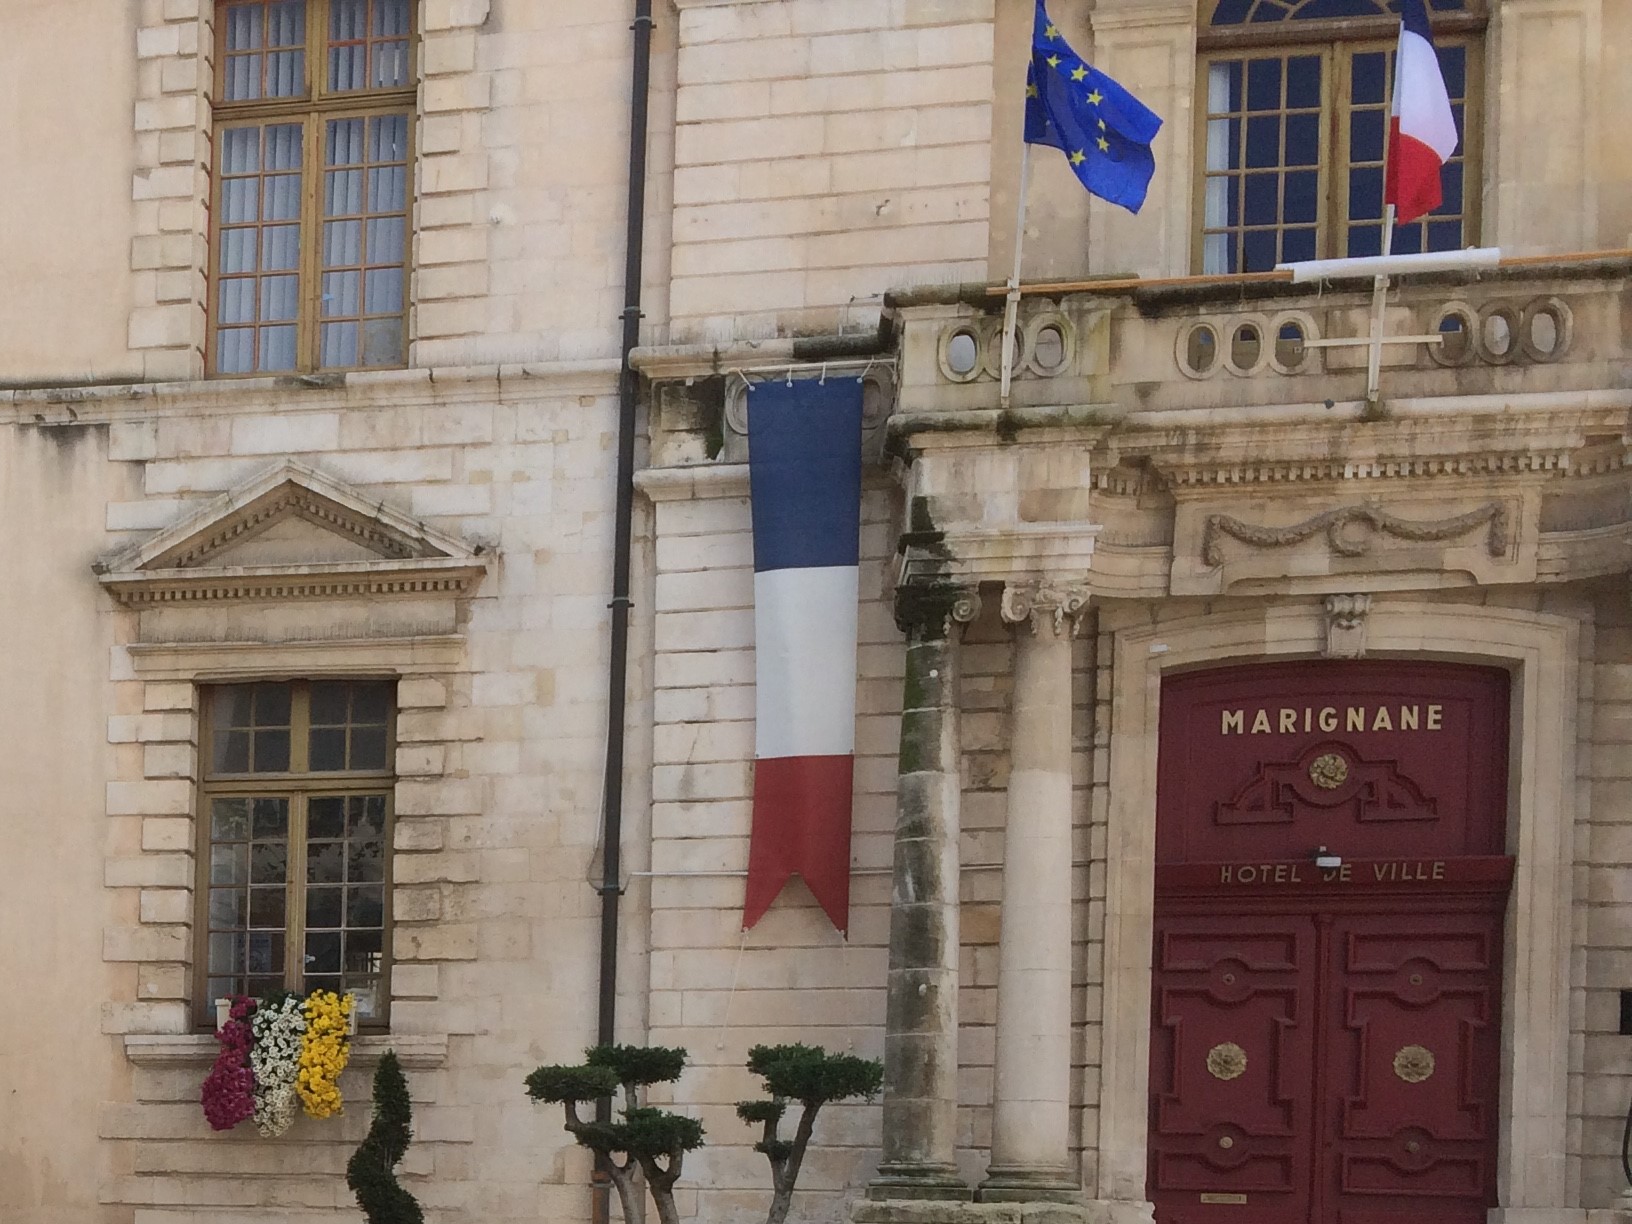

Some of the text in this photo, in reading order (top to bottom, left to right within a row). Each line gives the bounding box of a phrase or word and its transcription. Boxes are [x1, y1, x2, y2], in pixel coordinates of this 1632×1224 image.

[1221, 705, 1443, 734] MARIGNANE
[1221, 865, 1302, 883] HOTEL
[1374, 862, 1445, 881] VILLE
